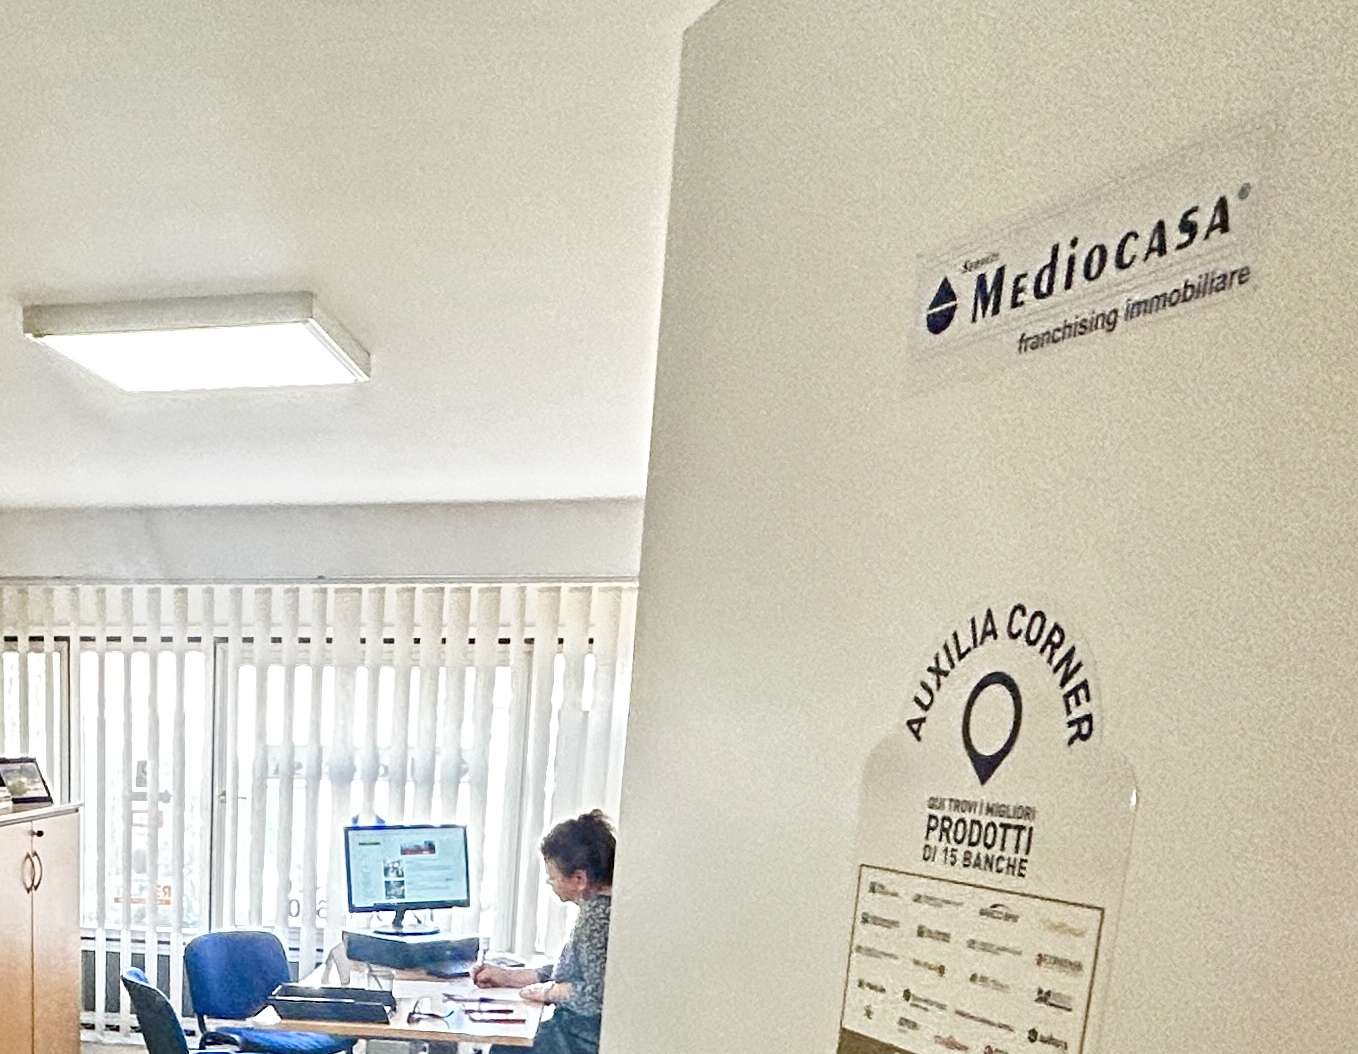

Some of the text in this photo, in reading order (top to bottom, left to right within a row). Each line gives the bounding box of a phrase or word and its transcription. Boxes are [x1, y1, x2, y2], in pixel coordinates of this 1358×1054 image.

[1017, 264, 1251, 354] franchising immobiliare
[906, 603, 1094, 747] AUXILIA CORNER
[927, 796, 945, 811] QUI
[948, 797, 978, 815] TROVI
[985, 801, 1036, 822] MIGLIORI
[925, 814, 1034, 856] PRODOTTI
[922, 844, 1029, 878] DI 15 BANCHE
